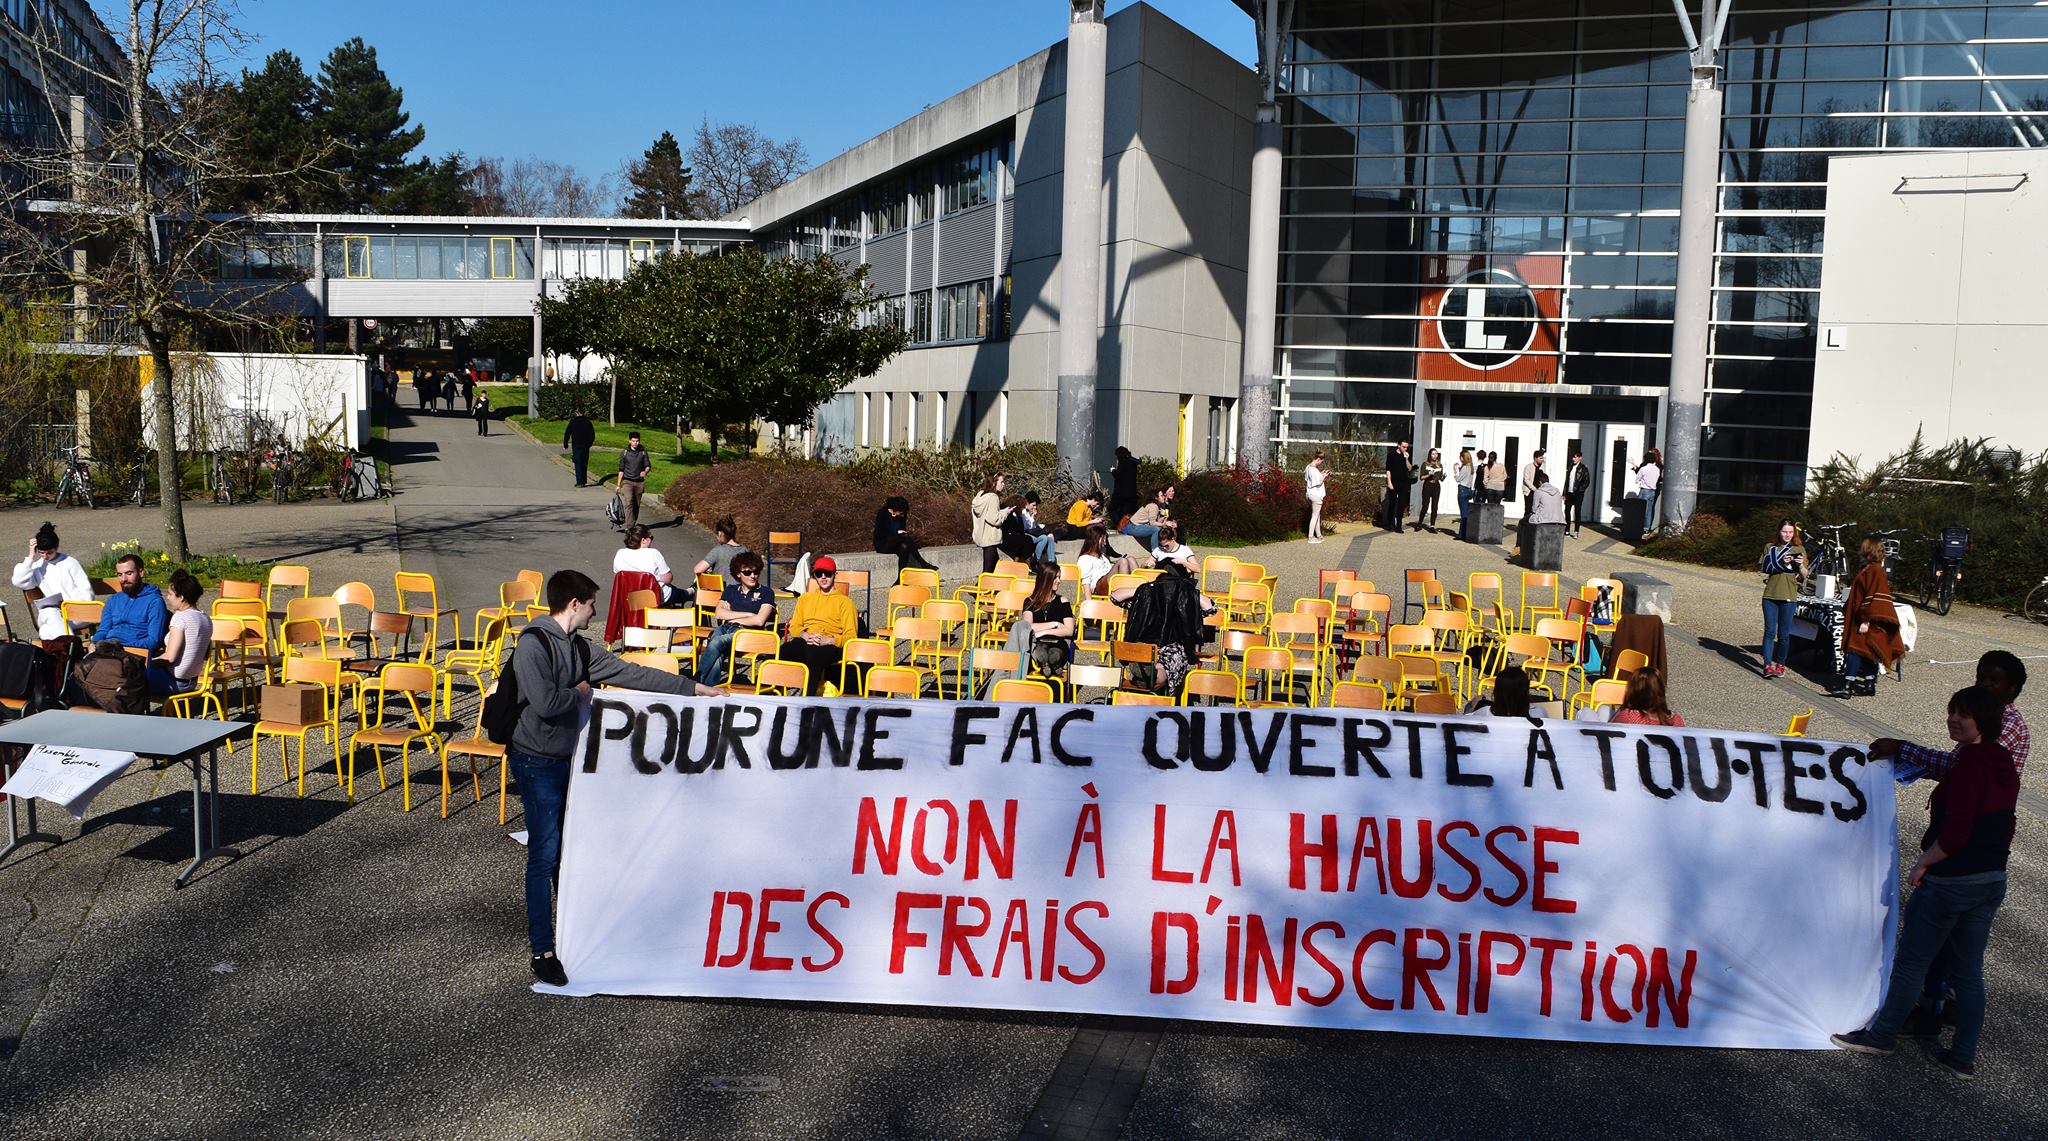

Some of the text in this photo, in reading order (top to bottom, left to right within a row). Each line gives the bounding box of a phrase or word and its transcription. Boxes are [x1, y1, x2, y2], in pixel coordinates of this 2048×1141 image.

[1464, 287, 1508, 350] L
[1827, 328, 1840, 348] L
[950, 706, 1095, 767] FAC
[1142, 709, 1495, 788] OUVERTE
[1523, 717, 1564, 791] À
[852, 783, 1580, 914] NON À LA HAUSSE
[703, 888, 850, 973] DES
